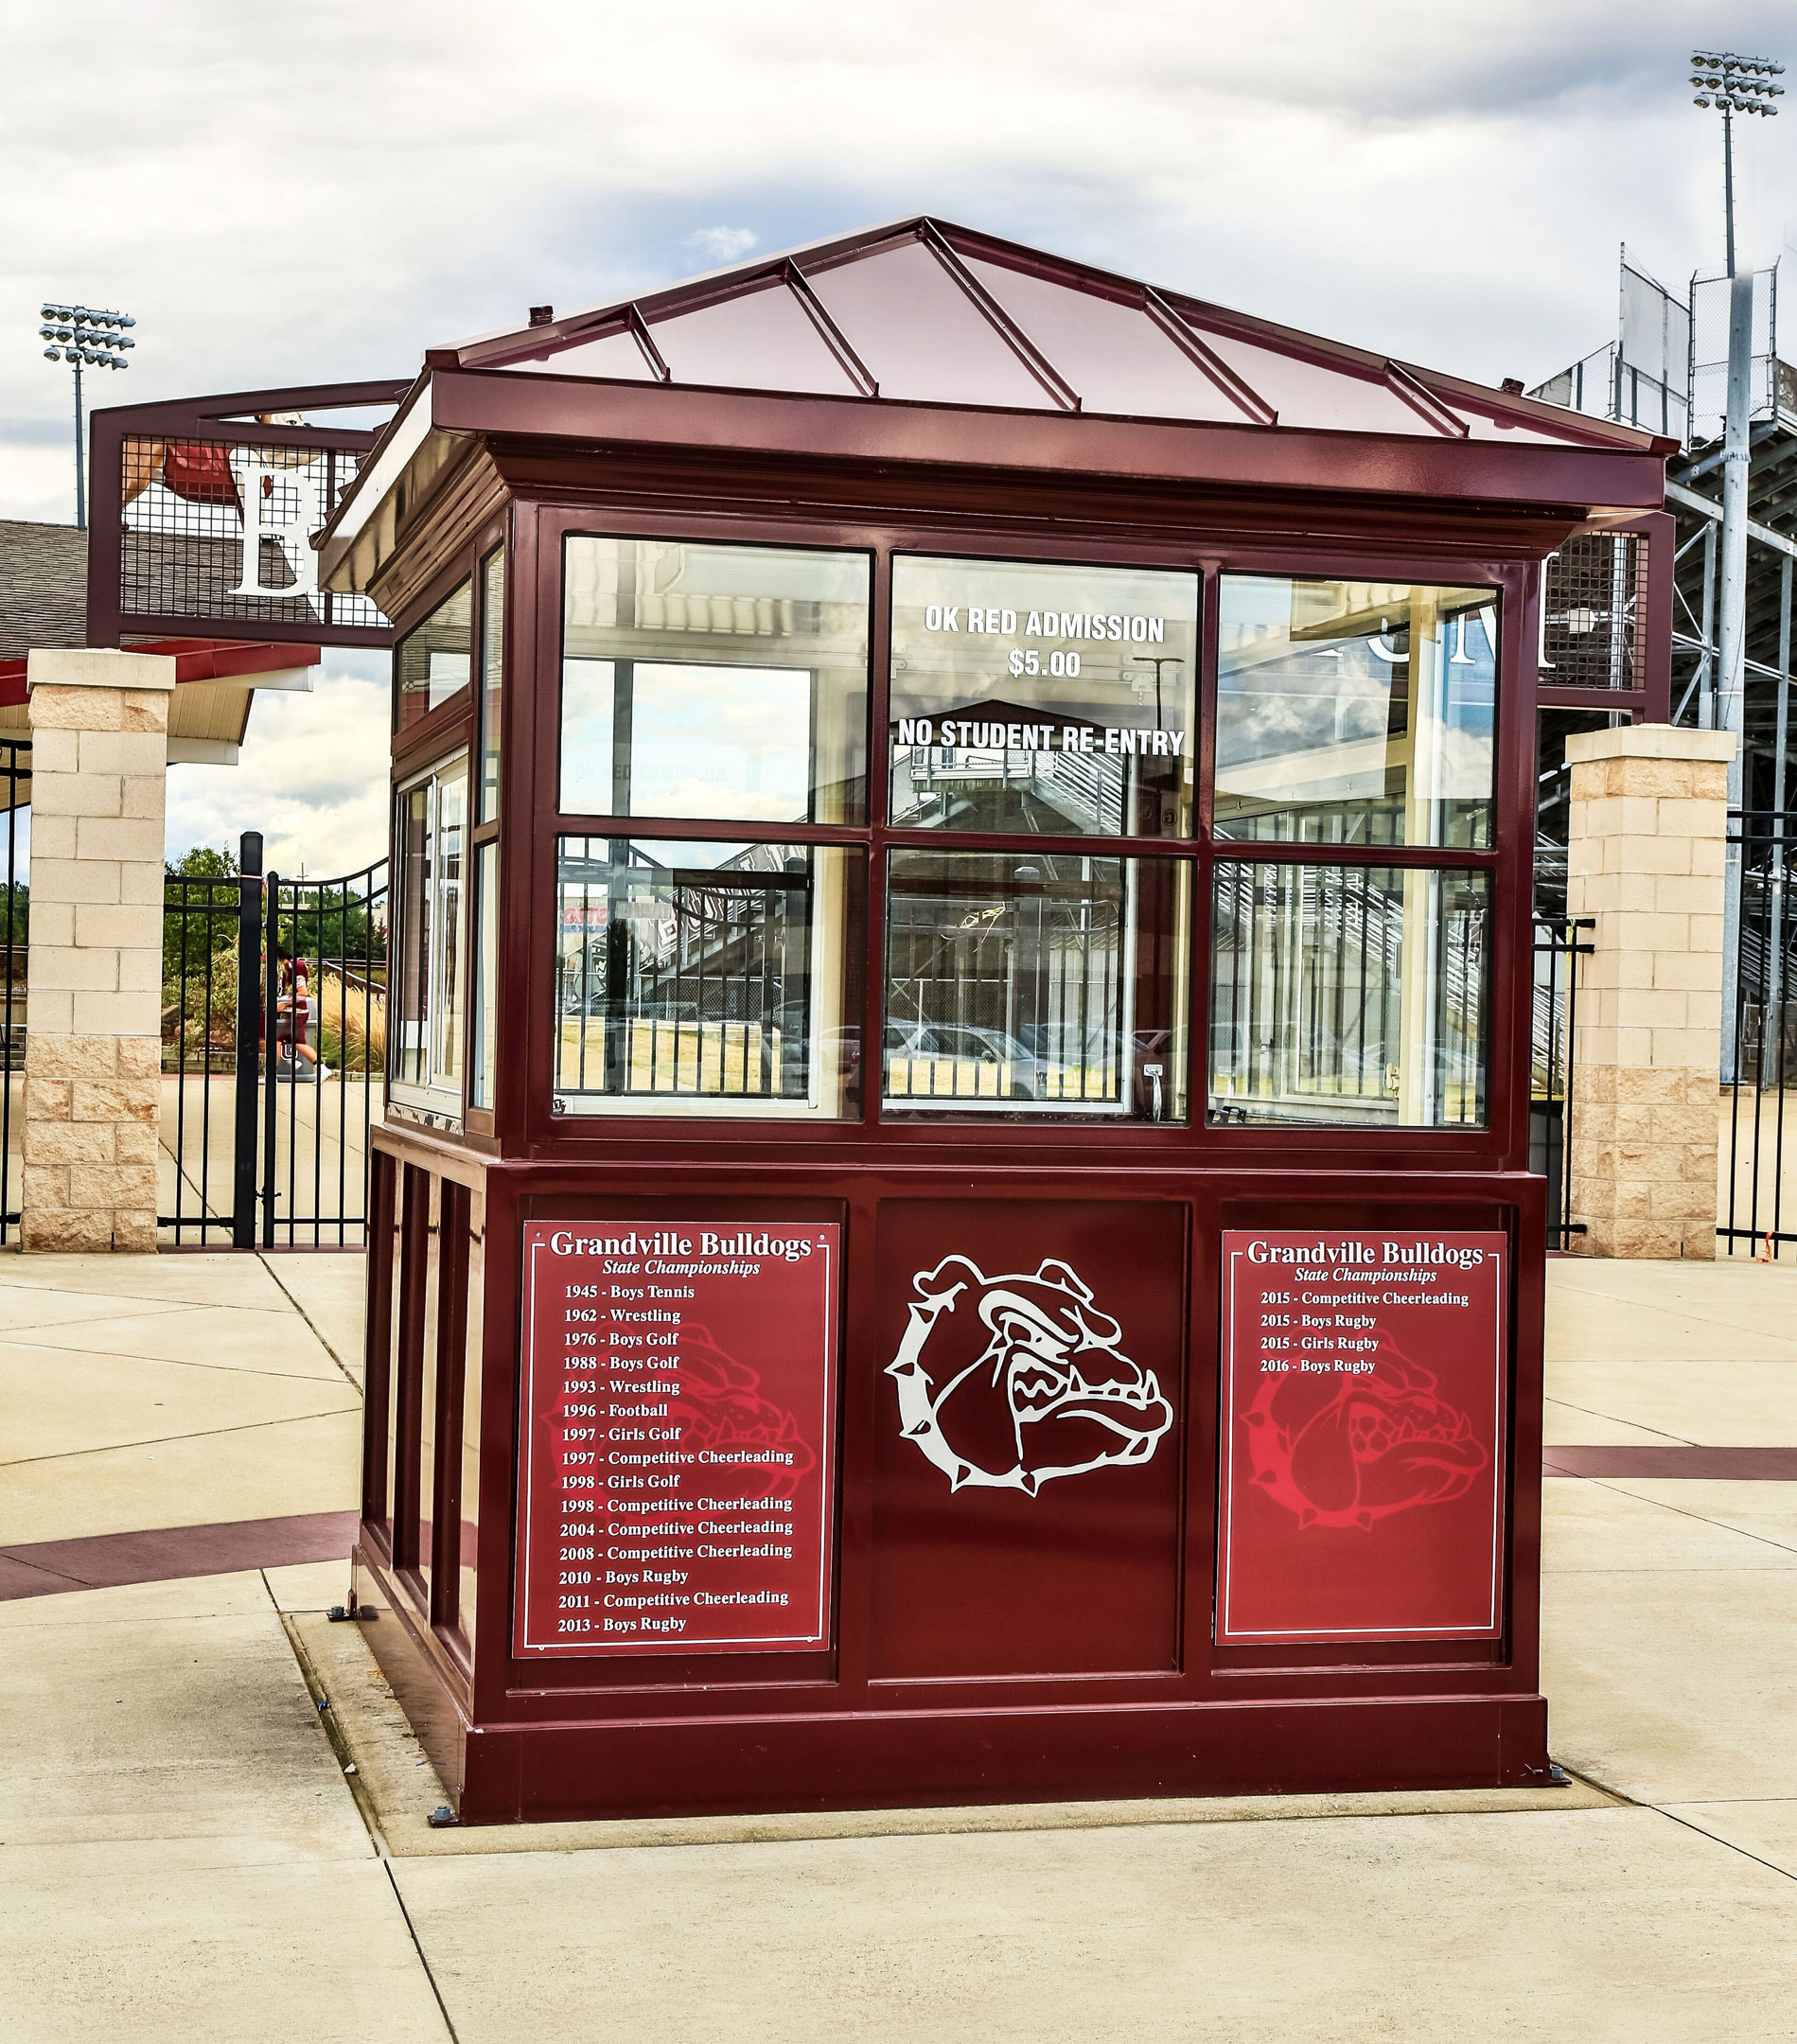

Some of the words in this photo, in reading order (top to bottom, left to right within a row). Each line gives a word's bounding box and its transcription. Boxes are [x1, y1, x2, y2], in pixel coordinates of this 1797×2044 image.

[227, 465, 319, 598] B
[925, 605, 960, 633] OK
[967, 608, 1017, 635] RED
[1025, 610, 1165, 643] ADMISSION
[1008, 647, 1081, 678] $5.00
[899, 718, 933, 747] NO
[941, 720, 1055, 751] STUDENT
[1062, 726, 1185, 757] RE-ENTRY
[551, 1232, 692, 1255] Grandville
[699, 1233, 811, 1260] Bulldogs
[1248, 1242, 1375, 1263] Grandville
[1383, 1242, 1483, 1269] Bulldogs
[603, 1260, 640, 1274] State
[644, 1260, 760, 1278] Championships
[1295, 1268, 1329, 1281] State
[1332, 1268, 1436, 1285] Championships
[566, 1285, 597, 1297] 1945
[610, 1285, 643, 1300] Boys
[647, 1286, 695, 1297] Tennis
[1260, 1292, 1290, 1303] 2015
[1302, 1292, 1380, 1307] Competitive
[1383, 1293, 1469, 1307] Cheerleading
[565, 1309, 597, 1321] 1962
[610, 1310, 680, 1325] Wrestling
[1260, 1314, 1290, 1326] 2015
[1302, 1314, 1331, 1329] Boys
[1335, 1314, 1376, 1330] Rugby
[565, 1333, 596, 1346] 1976
[609, 1333, 643, 1348] Boys
[646, 1332, 679, 1345] Golf
[1260, 1337, 1290, 1348] 2015
[1301, 1337, 1334, 1348] Girls
[1338, 1337, 1379, 1351] Rugby
[564, 1357, 596, 1369] 1988
[610, 1357, 643, 1372] Boys
[647, 1356, 679, 1368] Golf
[1260, 1360, 1289, 1371] 2016
[1300, 1360, 1330, 1374] Boys
[1334, 1360, 1375, 1374] Rugby
[564, 1381, 596, 1393] 1993
[609, 1381, 679, 1396] Wrestling
[563, 1404, 596, 1417] 1996
[609, 1404, 667, 1417] Football
[563, 1429, 595, 1440] 1997
[608, 1428, 644, 1440] Girls
[649, 1428, 681, 1440] Golf
[563, 1453, 595, 1465] 1997
[608, 1452, 695, 1467] Competitive
[698, 1450, 793, 1465] Cheerleading
[562, 1476, 594, 1489] 1998
[608, 1475, 643, 1488] Girls
[648, 1475, 680, 1488] Golf
[562, 1500, 594, 1512] 1998
[608, 1499, 694, 1514] Competitive
[697, 1497, 792, 1511] Cheerleading
[560, 1524, 594, 1536] 2004
[608, 1523, 694, 1538] Competitive
[697, 1521, 793, 1535] Cheerleading
[560, 1547, 593, 1560] 2008
[608, 1545, 693, 1561] Competitive
[697, 1543, 792, 1559] Cheerleading
[559, 1571, 590, 1584] 2010
[606, 1571, 639, 1586] Boys
[643, 1570, 688, 1585] Rugby
[558, 1595, 590, 1608] 2011
[604, 1593, 690, 1609] Competitive
[694, 1591, 788, 1606] Cheerleading
[558, 1619, 590, 1631] 2013
[604, 1618, 637, 1633] Boys
[641, 1617, 686, 1632] Rugby
